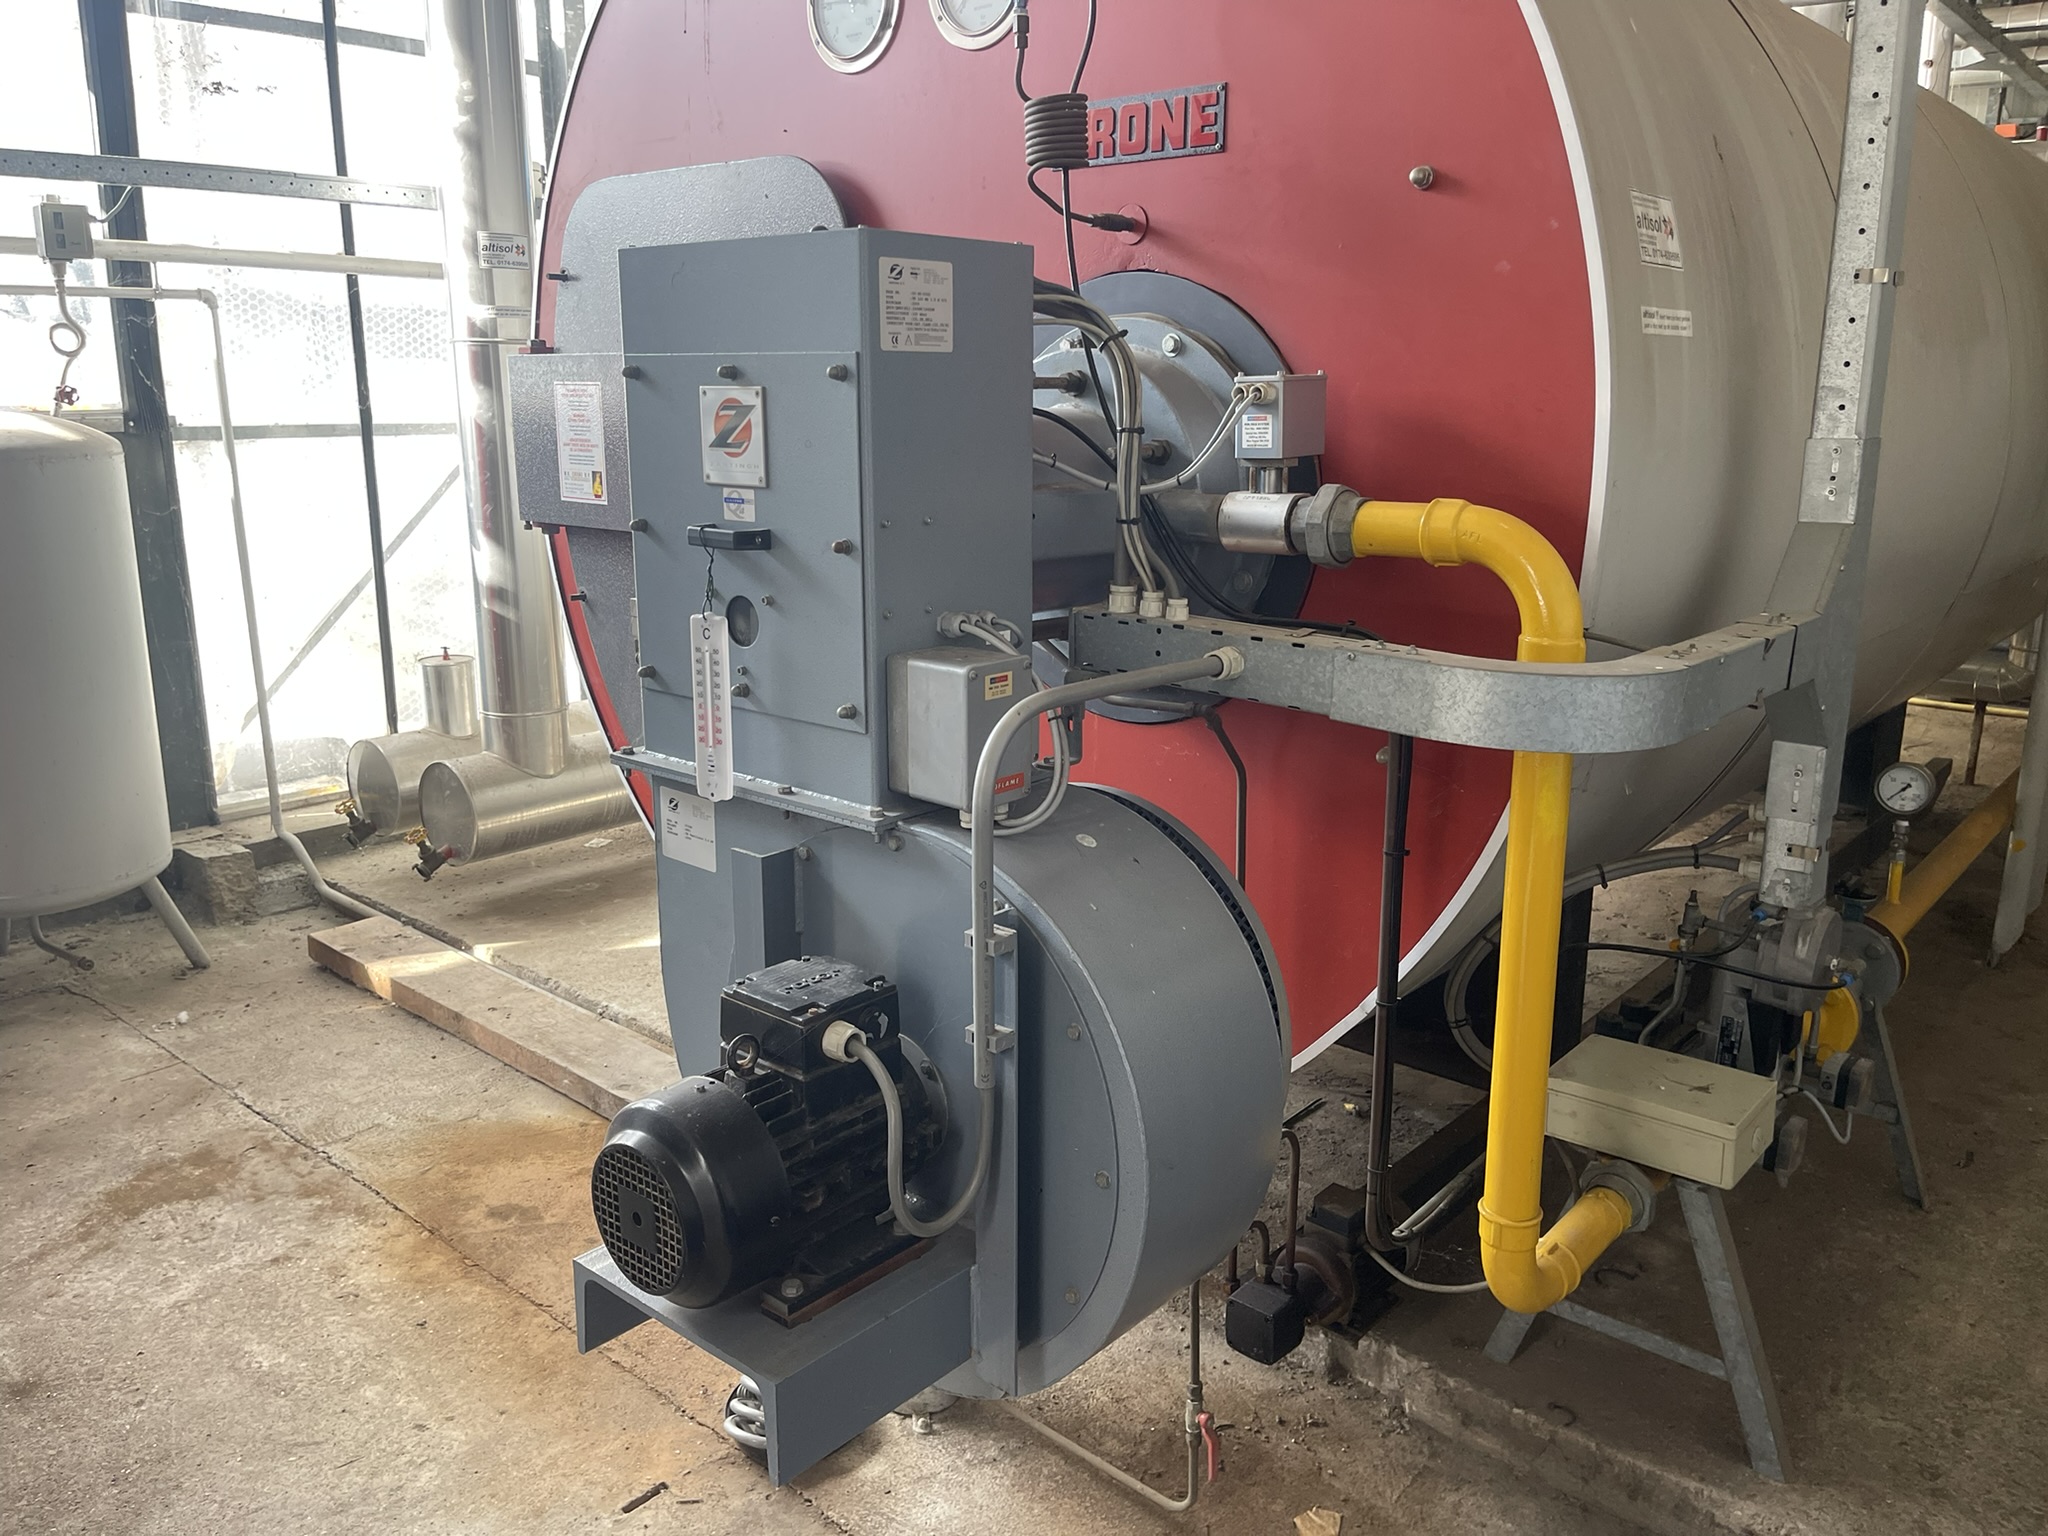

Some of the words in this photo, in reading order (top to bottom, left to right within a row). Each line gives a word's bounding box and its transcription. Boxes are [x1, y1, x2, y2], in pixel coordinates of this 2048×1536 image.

[1087, 91, 1218, 160] RONE
[1636, 211, 1663, 233] altisol
[481, 242, 514, 253] altisol
[702, 627, 711, 640] C
[995, 777, 1020, 790] FLAME
